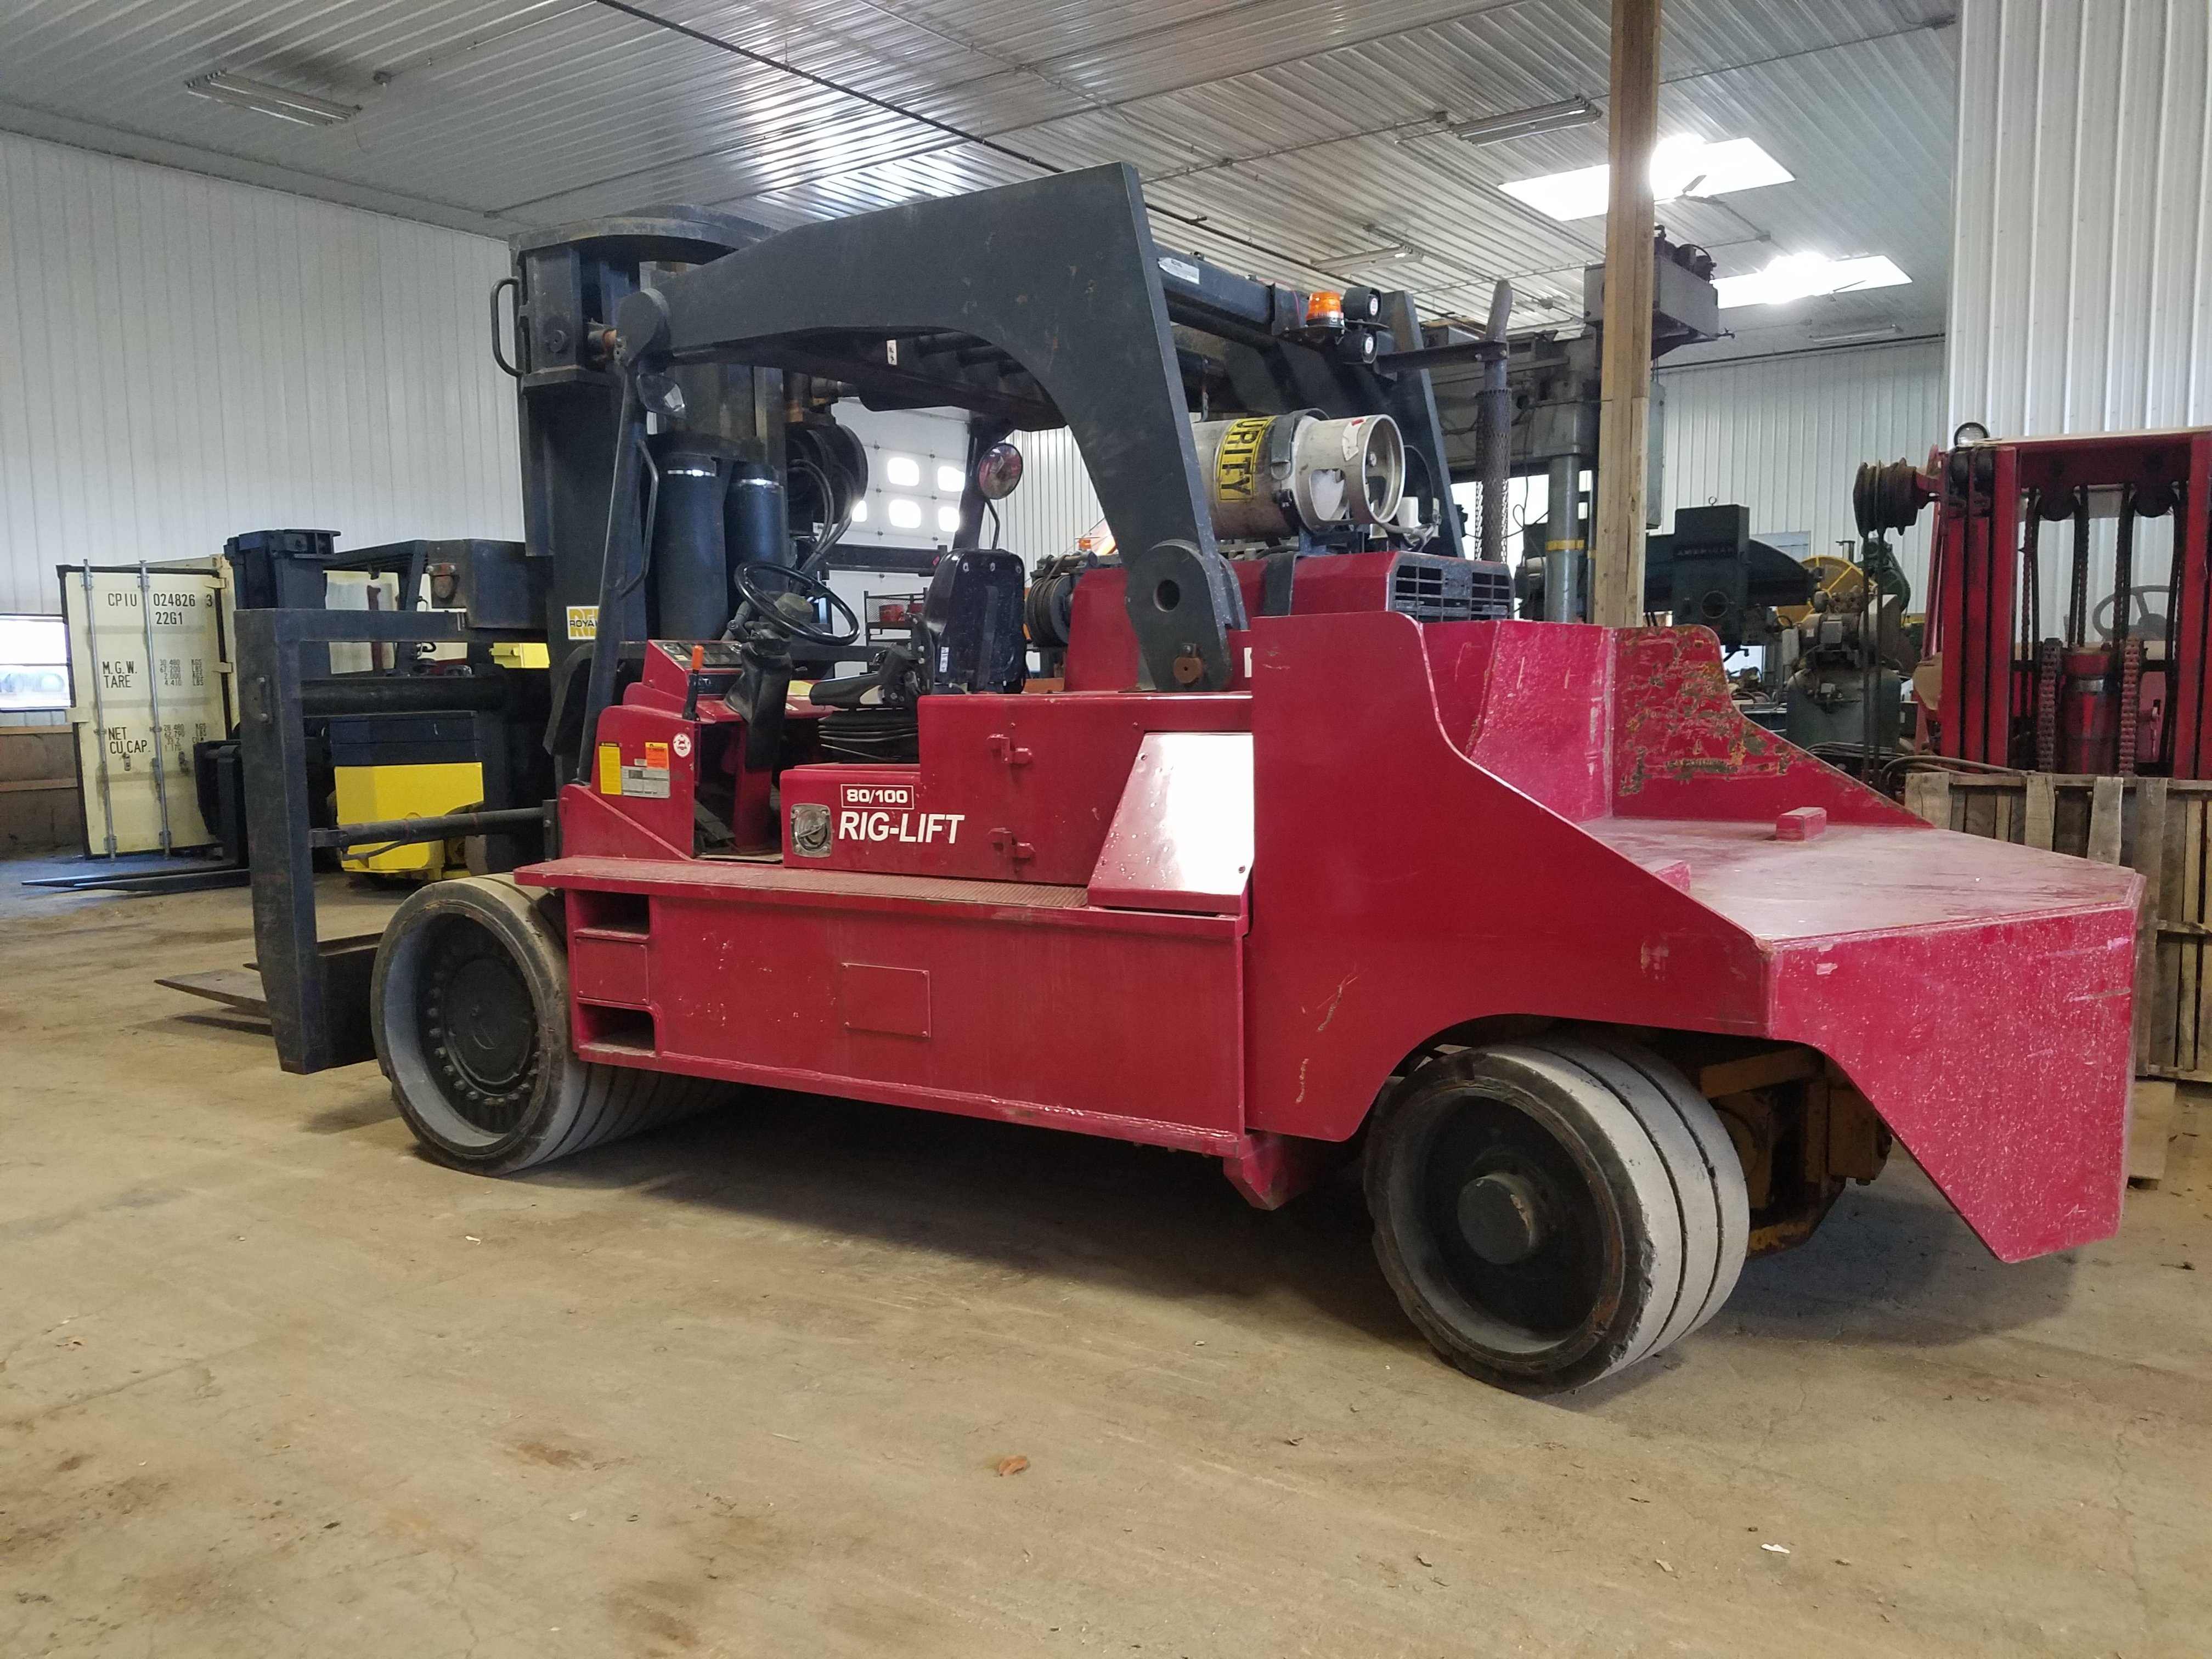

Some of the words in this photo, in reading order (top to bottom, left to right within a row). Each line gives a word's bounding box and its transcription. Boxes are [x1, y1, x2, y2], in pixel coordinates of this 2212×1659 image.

[108, 593, 137, 607] CPIU
[153, 594, 195, 607] 024826
[206, 594, 213, 607] 3
[155, 612, 183, 625] 22G1
[104, 675, 132, 688] TARE
[108, 727, 127, 741] NET
[847, 789, 908, 804] 80/100
[839, 811, 965, 844] RIG-LIFT
